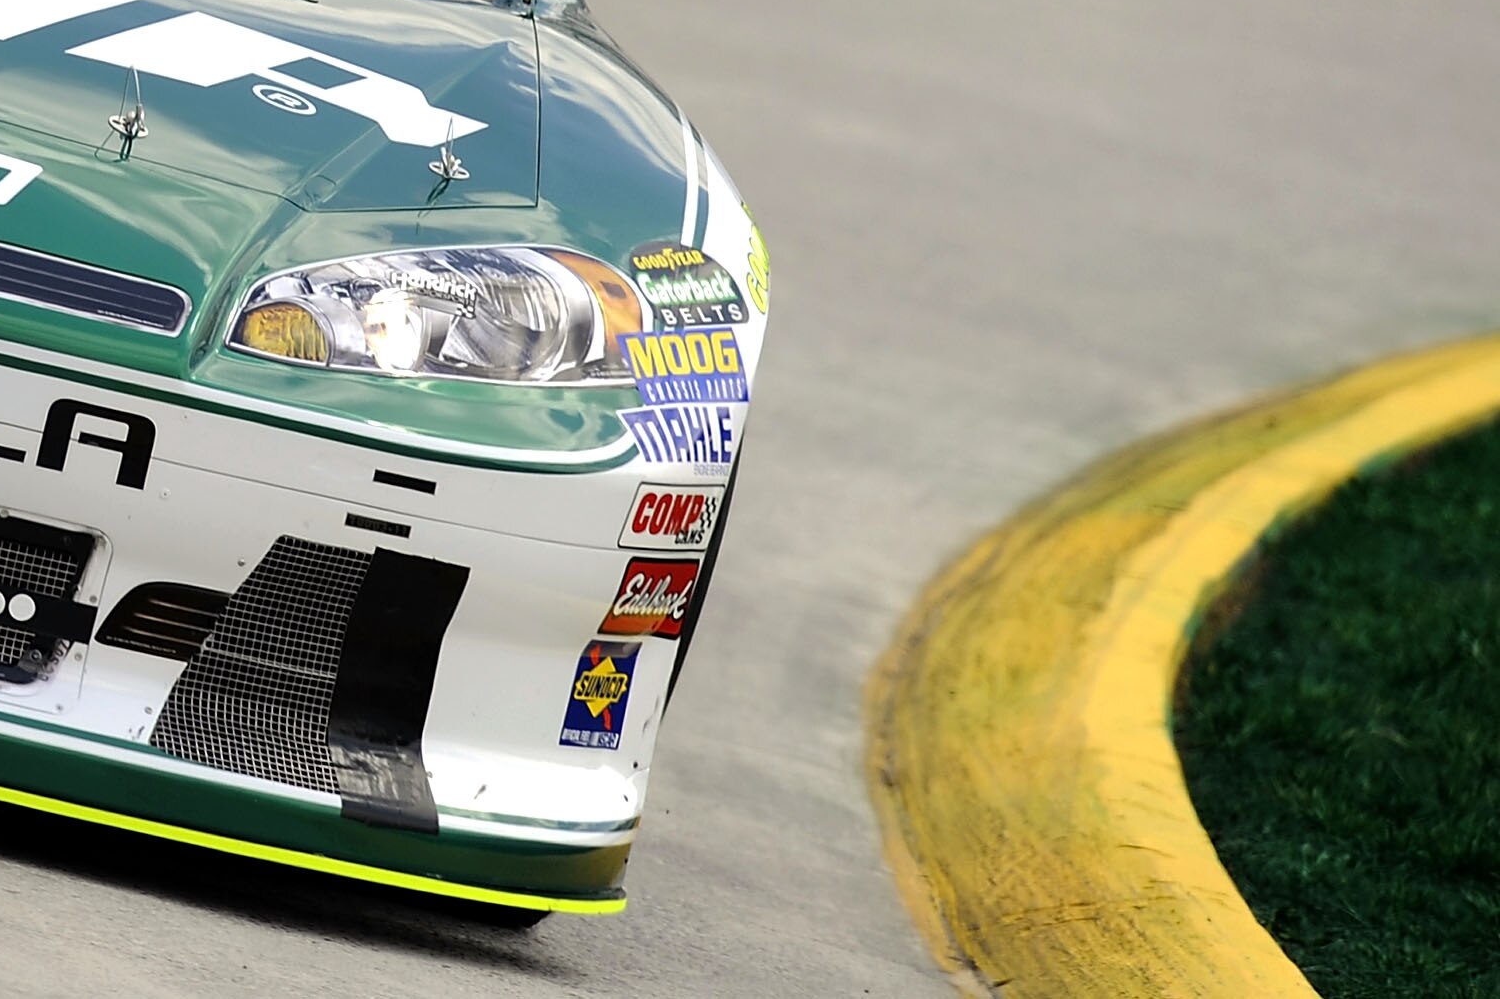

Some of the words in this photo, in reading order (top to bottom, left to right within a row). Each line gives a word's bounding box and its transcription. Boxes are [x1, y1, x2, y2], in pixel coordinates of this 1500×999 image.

[632, 248, 705, 271] GOODYEAR
[390, 271, 477, 301] Hendrick
[636, 271, 738, 304] Gatorback
[661, 303, 743, 326] BELTS
[625, 332, 740, 380] MOOG
[646, 380, 701, 403] CHASSIS
[621, 406, 732, 463] MAHLE
[631, 492, 705, 536] COMP
[674, 529, 704, 545] CAMS
[576, 674, 626, 699] SUNOCO
